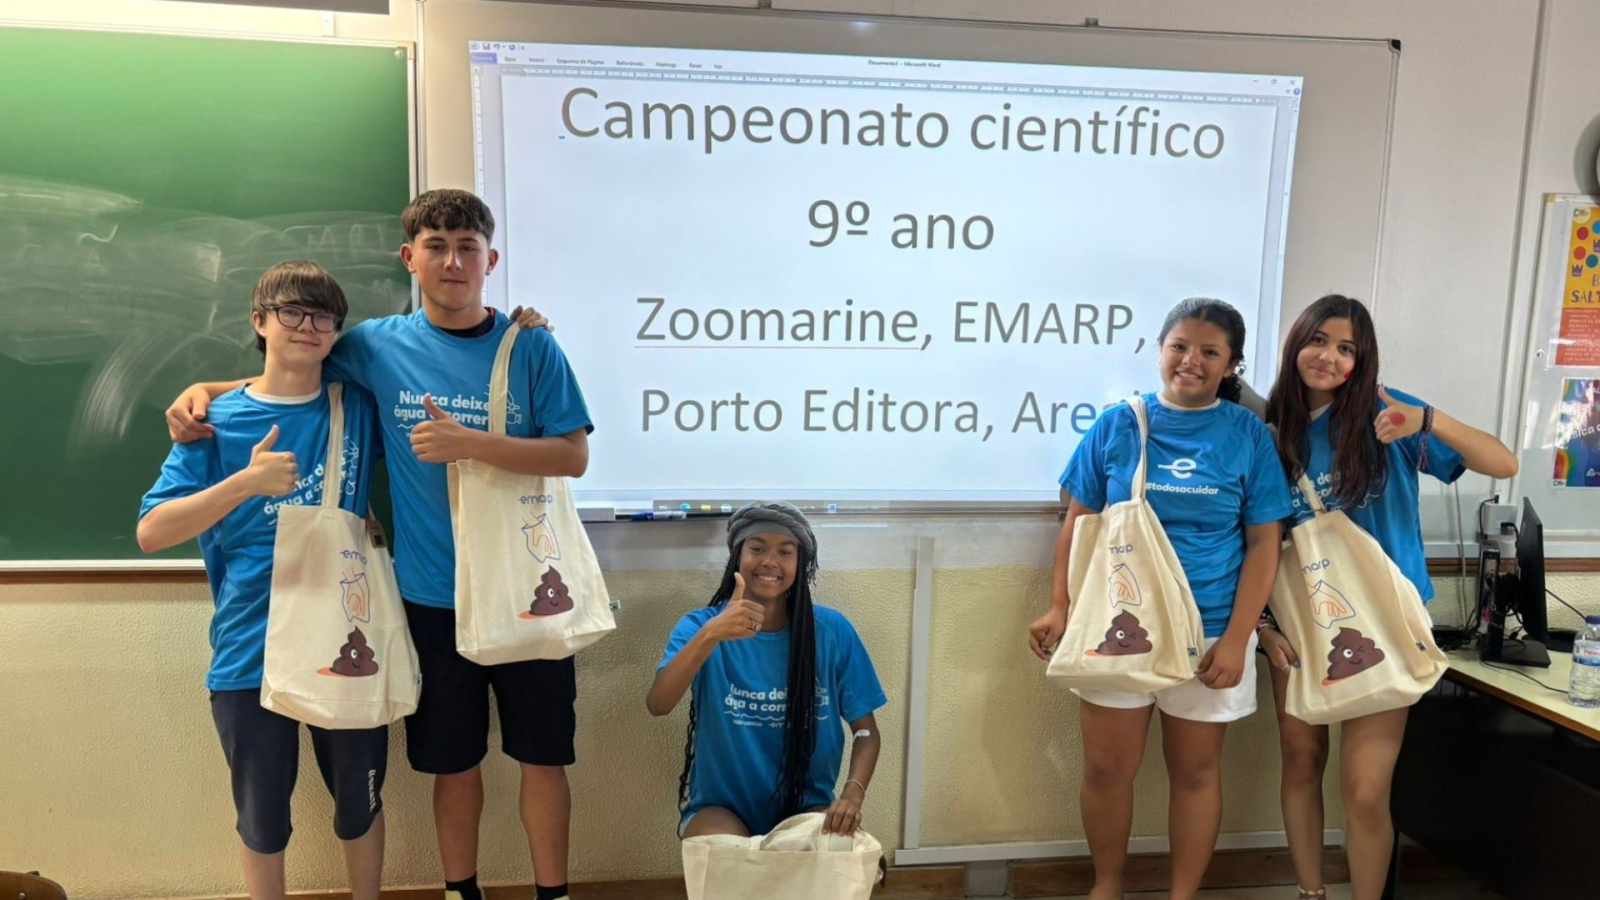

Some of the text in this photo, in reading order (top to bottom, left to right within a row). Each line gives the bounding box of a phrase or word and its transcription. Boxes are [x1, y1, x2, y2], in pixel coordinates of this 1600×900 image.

[561, 87, 1225, 159] Campeonato científico
[808, 199, 994, 251] 9º ano
[636, 297, 1146, 354] Zoomarine, EMARP,
[394, 405, 426, 421] água
[642, 389, 783, 433] Porto
[803, 387, 993, 443] Editora,
[1145, 482, 1219, 495] #todosacuidar
[748, 702, 758, 710] a
[768, 687, 788, 700] dei
